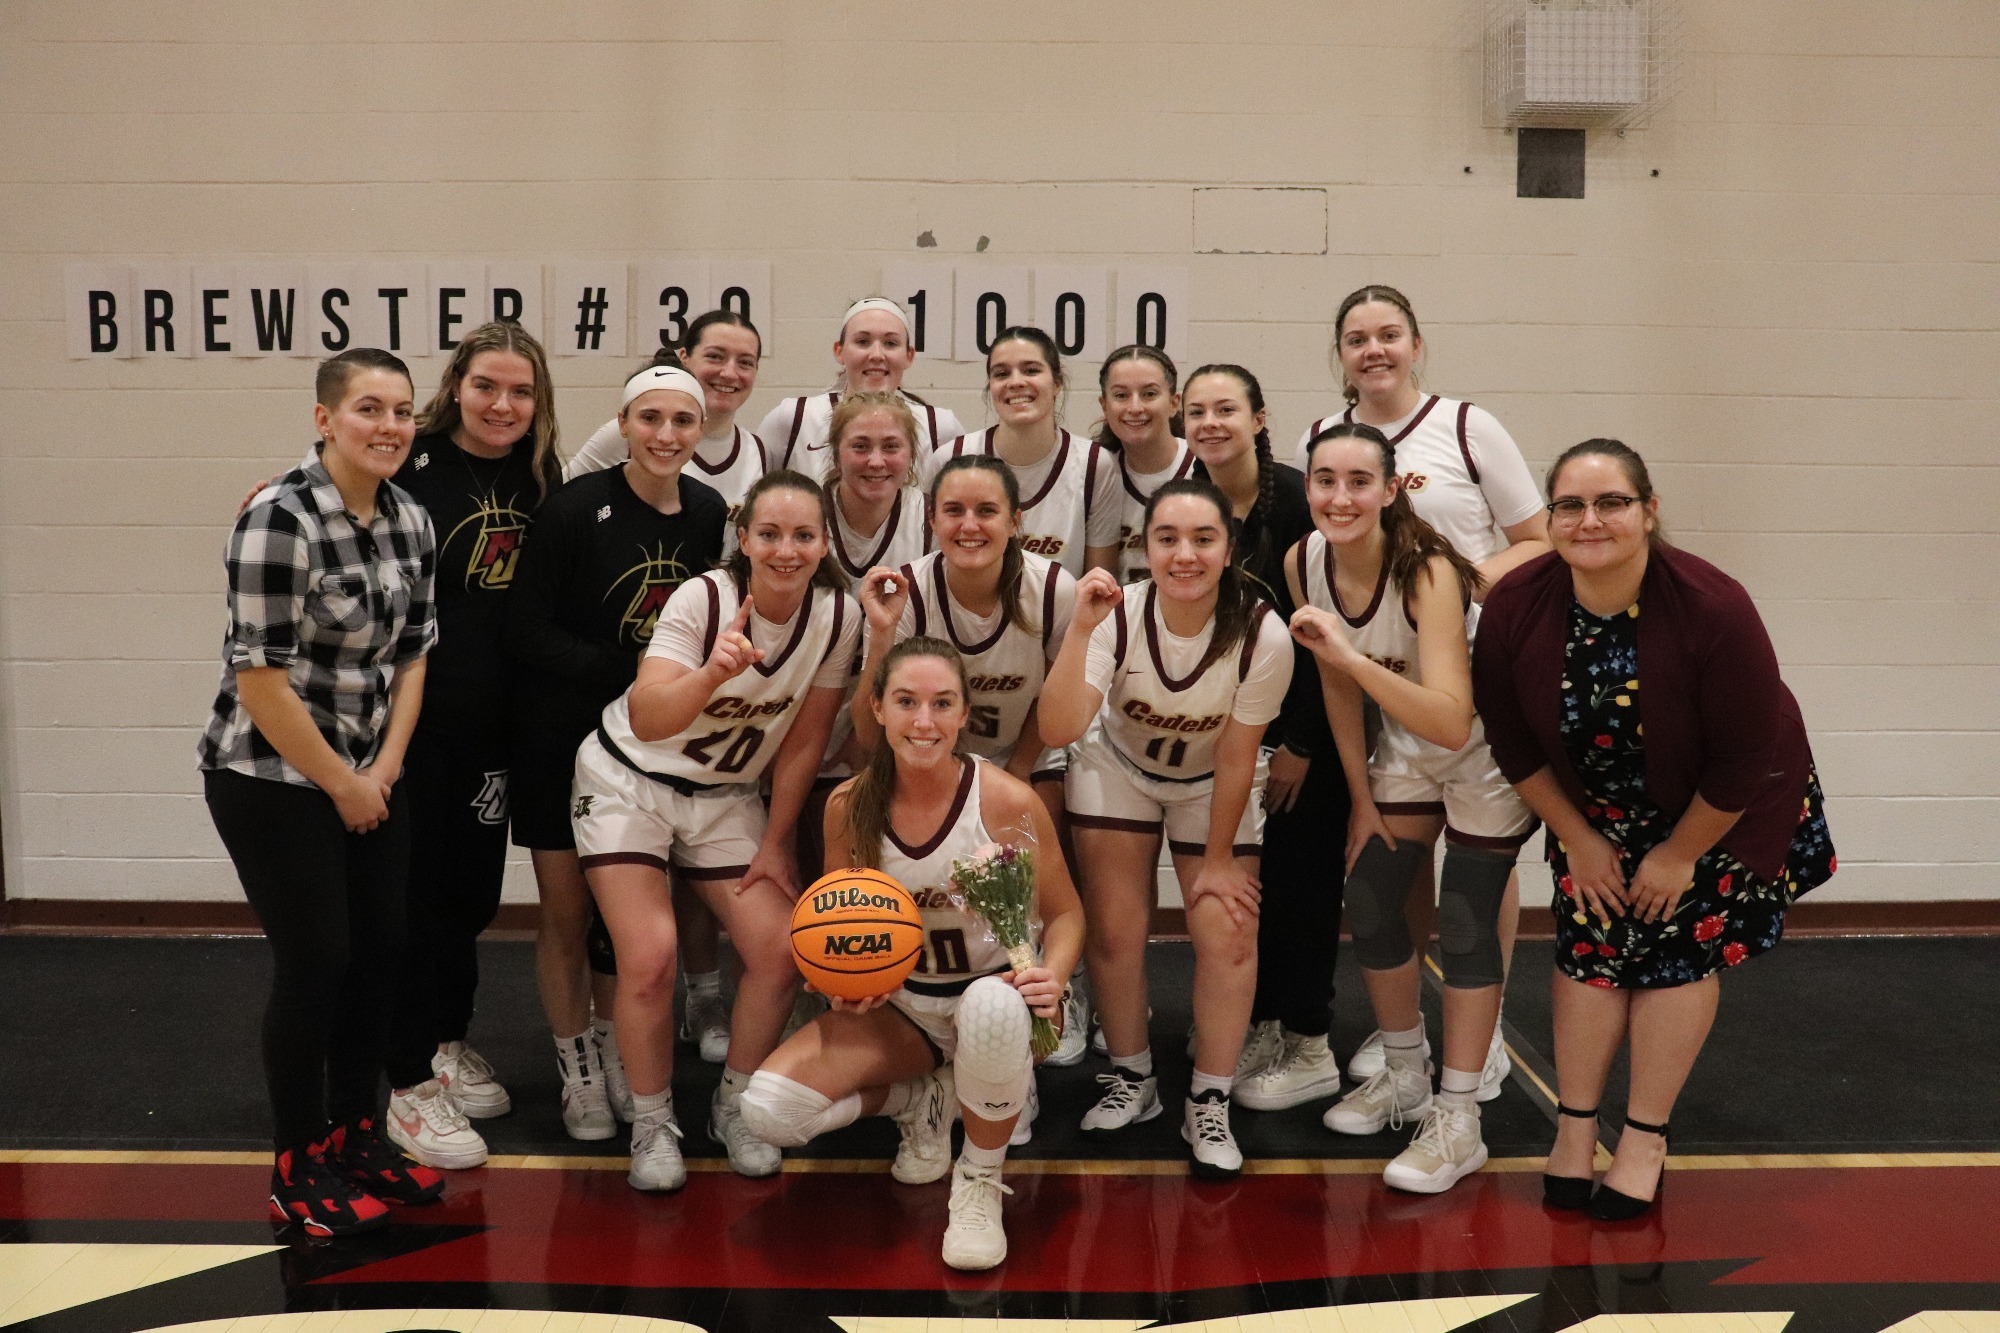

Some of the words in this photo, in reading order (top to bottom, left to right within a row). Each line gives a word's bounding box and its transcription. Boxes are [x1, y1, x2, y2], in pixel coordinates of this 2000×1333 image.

[88, 287, 523, 353] BREWSTER
[907, 289, 1167, 356] 1000
[969, 675, 1024, 692] dets
[1123, 700, 1224, 732] Cadets
[1145, 736, 1187, 768] 11
[813, 887, 901, 914] Wilson
[824, 932, 892, 955] NCAA
